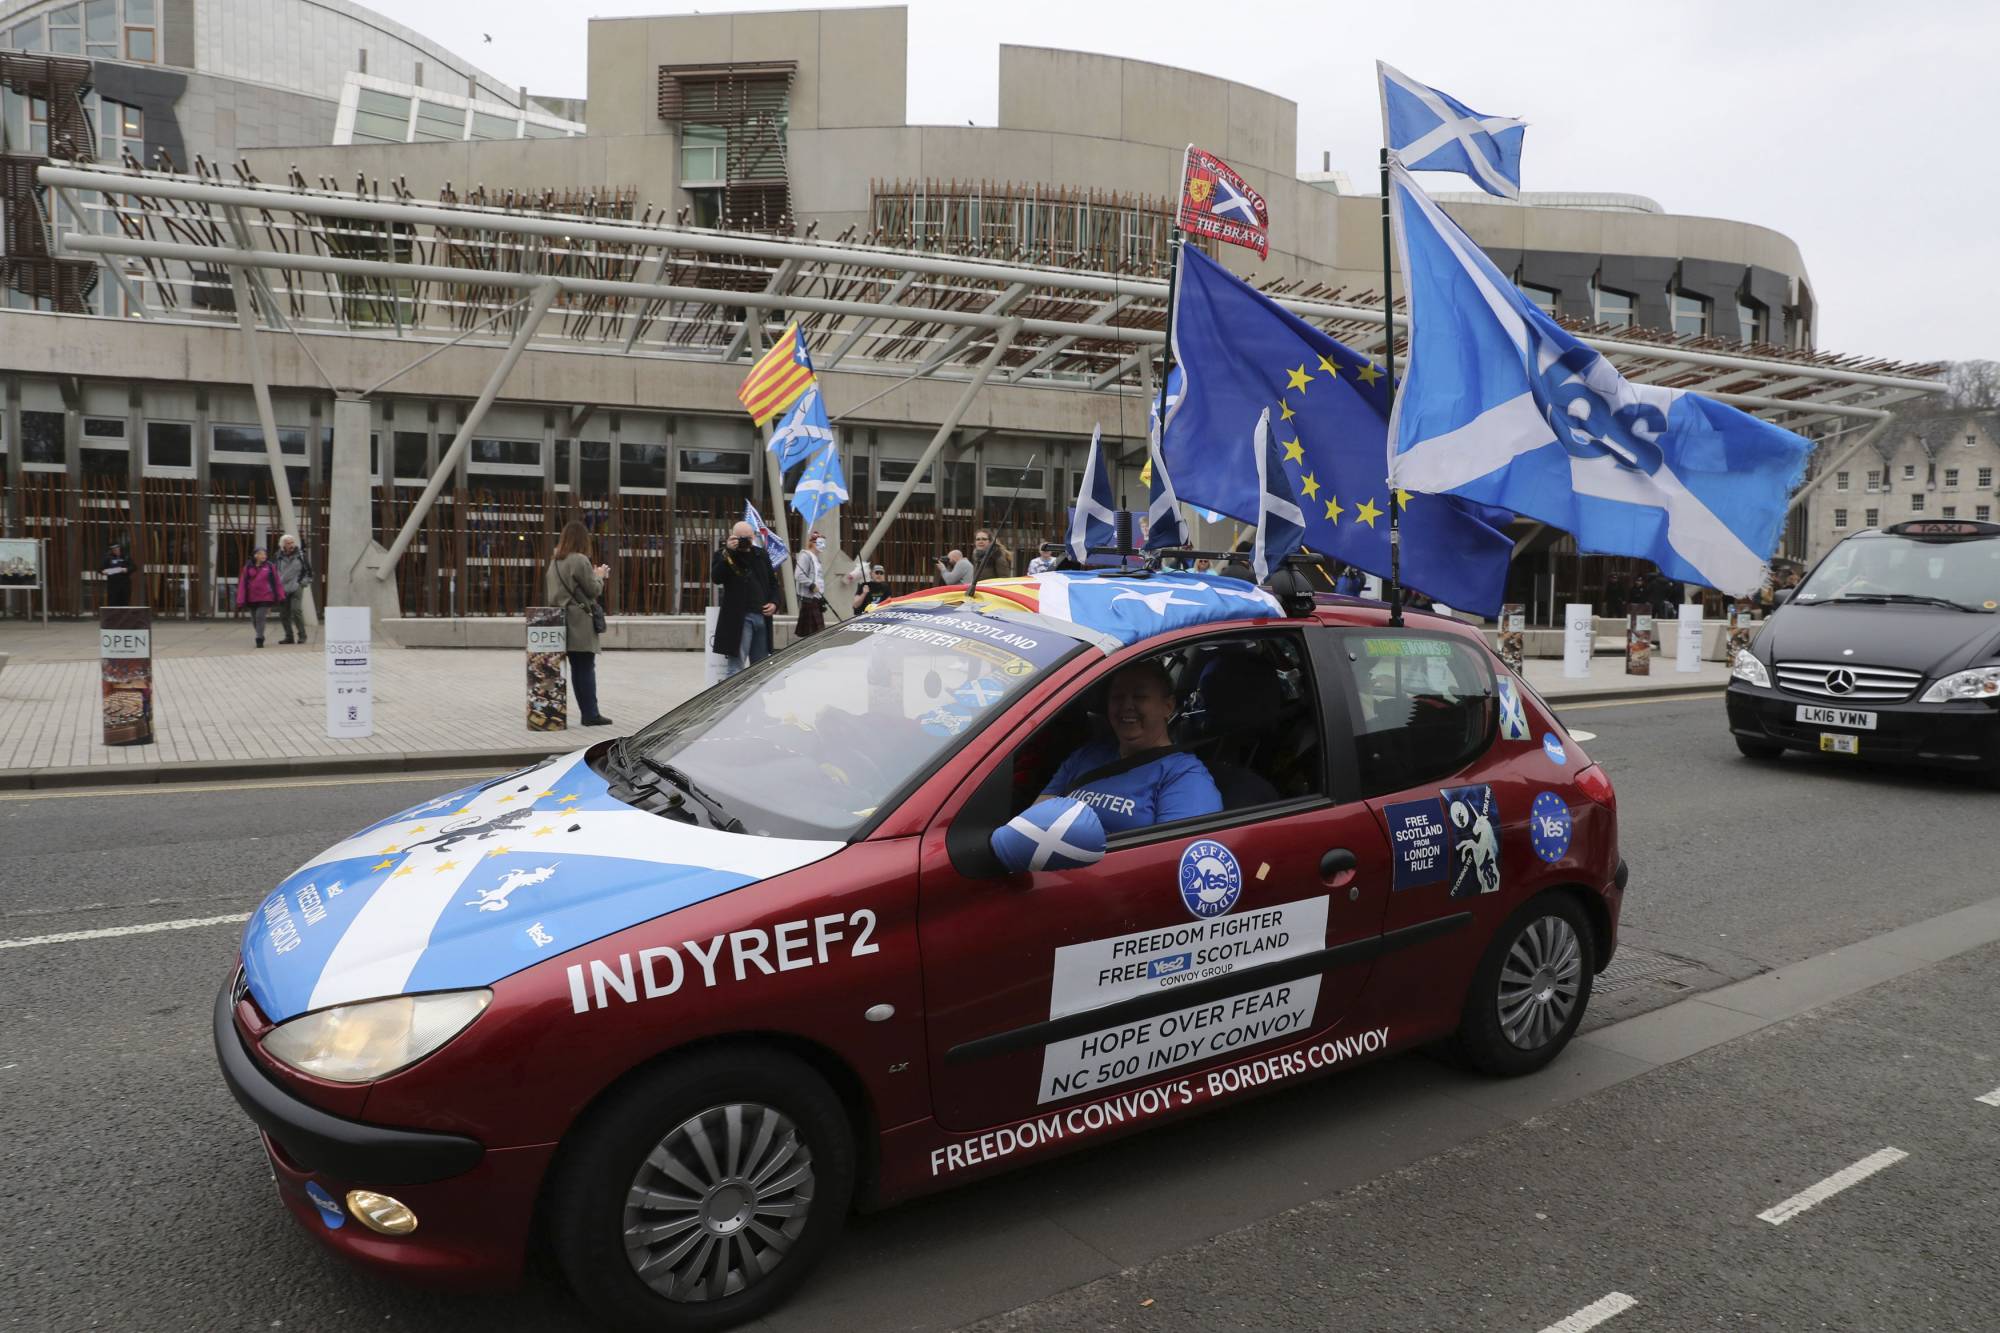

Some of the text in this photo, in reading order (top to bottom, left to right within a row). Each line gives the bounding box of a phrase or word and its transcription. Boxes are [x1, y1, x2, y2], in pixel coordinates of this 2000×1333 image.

[1200, 157, 1265, 210] SCOTLAND
[1197, 218, 1265, 246] THE BRAVE
[1919, 524, 1962, 534] TAXI
[103, 634, 147, 648] OPEN
[529, 631, 566, 643] OPEN
[838, 623, 962, 648] FREEDOM FIGHTER
[934, 615, 960, 627] FOR
[956, 620, 1038, 650] SCOTLAND
[1804, 707, 1868, 726] LK16 VWN
[1395, 824, 1443, 842] SCOTLAND
[1404, 814, 1429, 828] FREE
[1539, 816, 1564, 838] Yes
[1404, 845, 1440, 861] LONDON
[1413, 838, 1430, 848] FROM
[1411, 858, 1434, 872] RULE
[1189, 845, 1238, 914] REFERENDUM
[295, 882, 328, 927] FREEDOM
[263, 893, 302, 955] CONVOY GROUP
[1112, 911, 1283, 959] FREEDOM FIGHTER
[567, 908, 880, 1014] INDYREF2
[1098, 962, 1148, 986] FREE
[1196, 932, 1289, 965] SCOTLAND
[1160, 963, 1233, 987] CONVOY GROUP
[1080, 987, 1291, 1059] HOPE OVER FEAR
[1051, 1009, 1305, 1096] NC 500 INDY CONVOY
[931, 1114, 1063, 1176] FREEDOM
[1066, 1080, 1193, 1134] CONVOY'S
[1207, 1051, 1306, 1097] BORDERS
[1308, 1026, 1389, 1068] CONVOY
